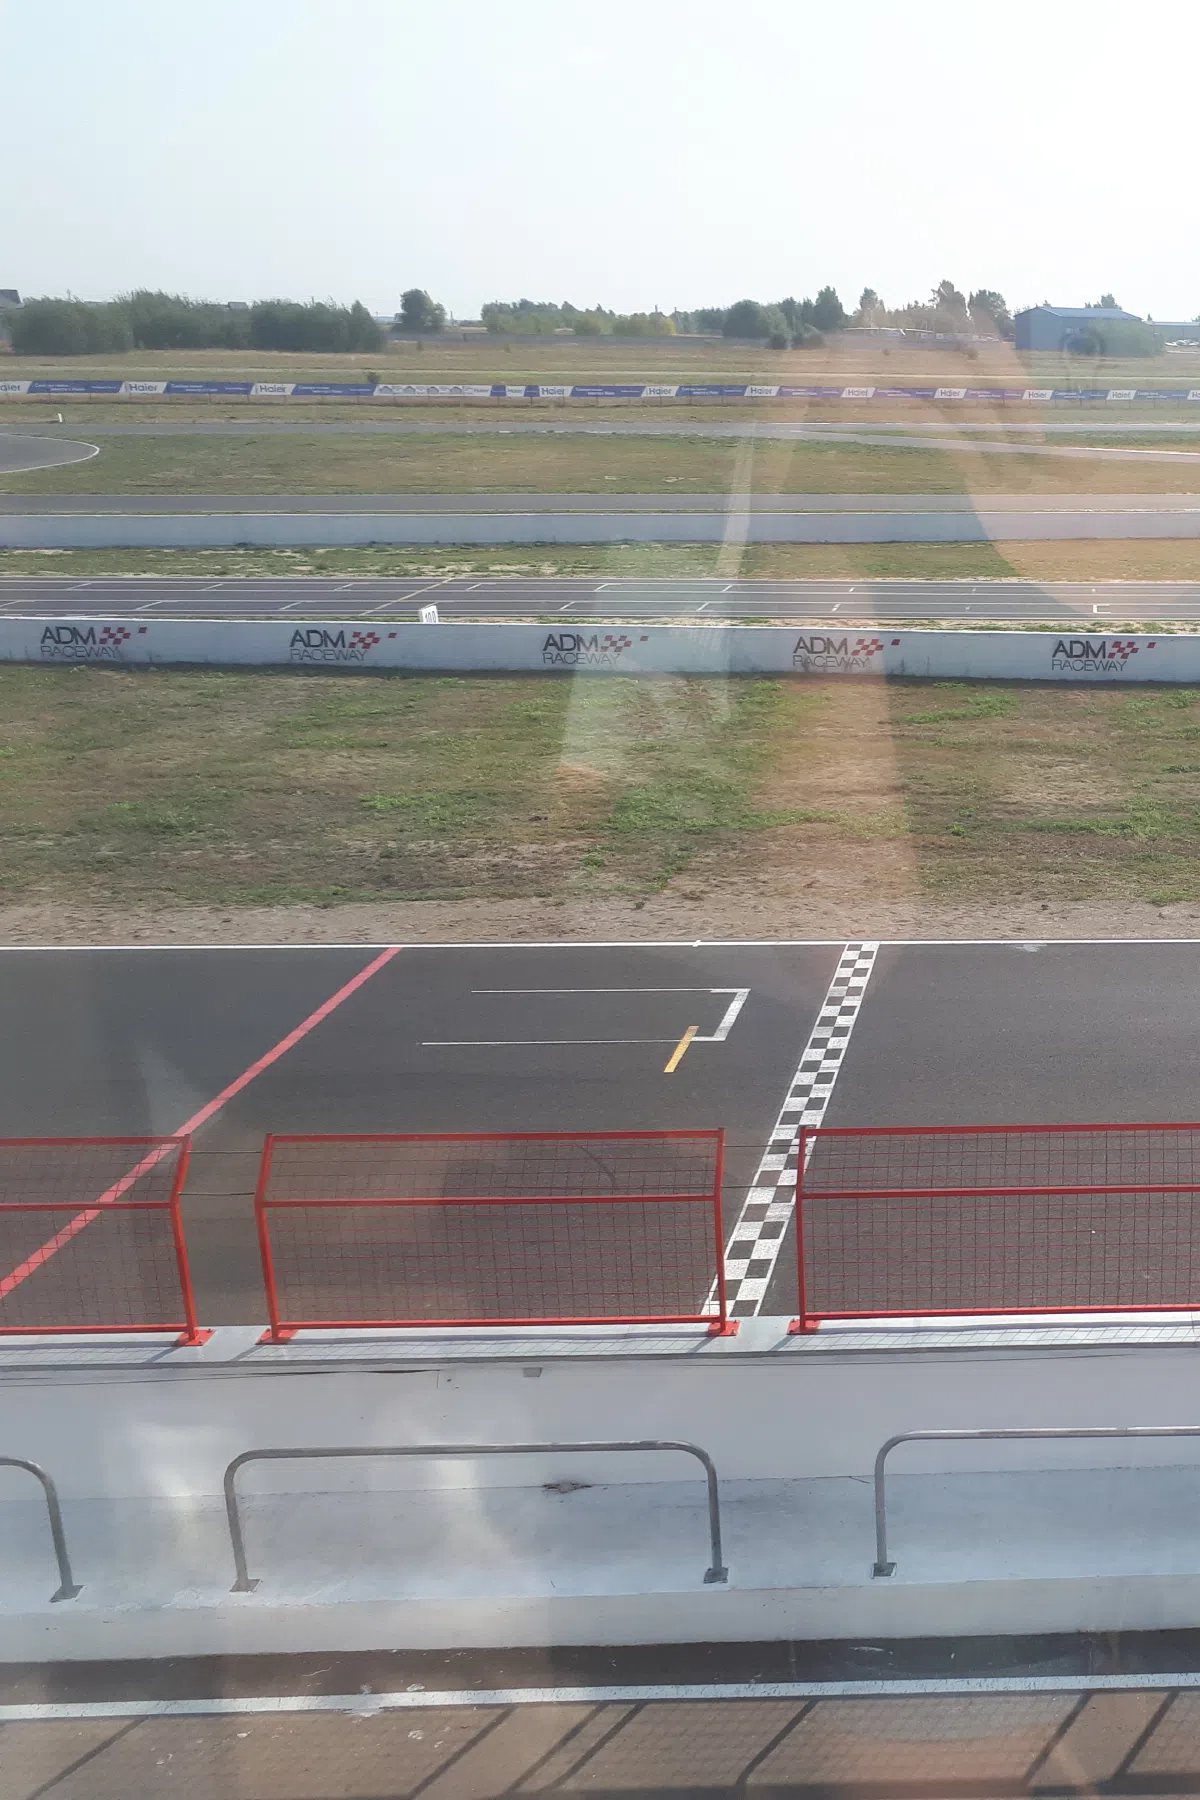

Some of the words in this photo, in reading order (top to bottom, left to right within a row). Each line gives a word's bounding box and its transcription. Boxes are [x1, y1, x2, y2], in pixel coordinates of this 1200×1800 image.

[0, 384, 20, 392] aier
[130, 383, 158, 392] Haier
[260, 384, 286, 393] Haier
[541, 387, 565, 396] Haier
[649, 387, 672, 396] Haier
[750, 387, 772, 396] Haier
[847, 388, 869, 397] Haier
[940, 389, 960, 398] Haier
[1028, 391, 1047, 399] Haier
[1112, 391, 1130, 399] Haier
[40, 627, 97, 645] ADM
[290, 630, 346, 648] ADM
[543, 633, 599, 652] ADM
[793, 636, 849, 655] ADM
[40, 645, 118, 659] RACEWAY
[290, 648, 367, 661] RACEWAY
[1052, 640, 1107, 659] ADM
[542, 652, 620, 665] RACEWAY
[792, 655, 869, 668] RACEWAY
[1051, 659, 1128, 672] RACEWAY
